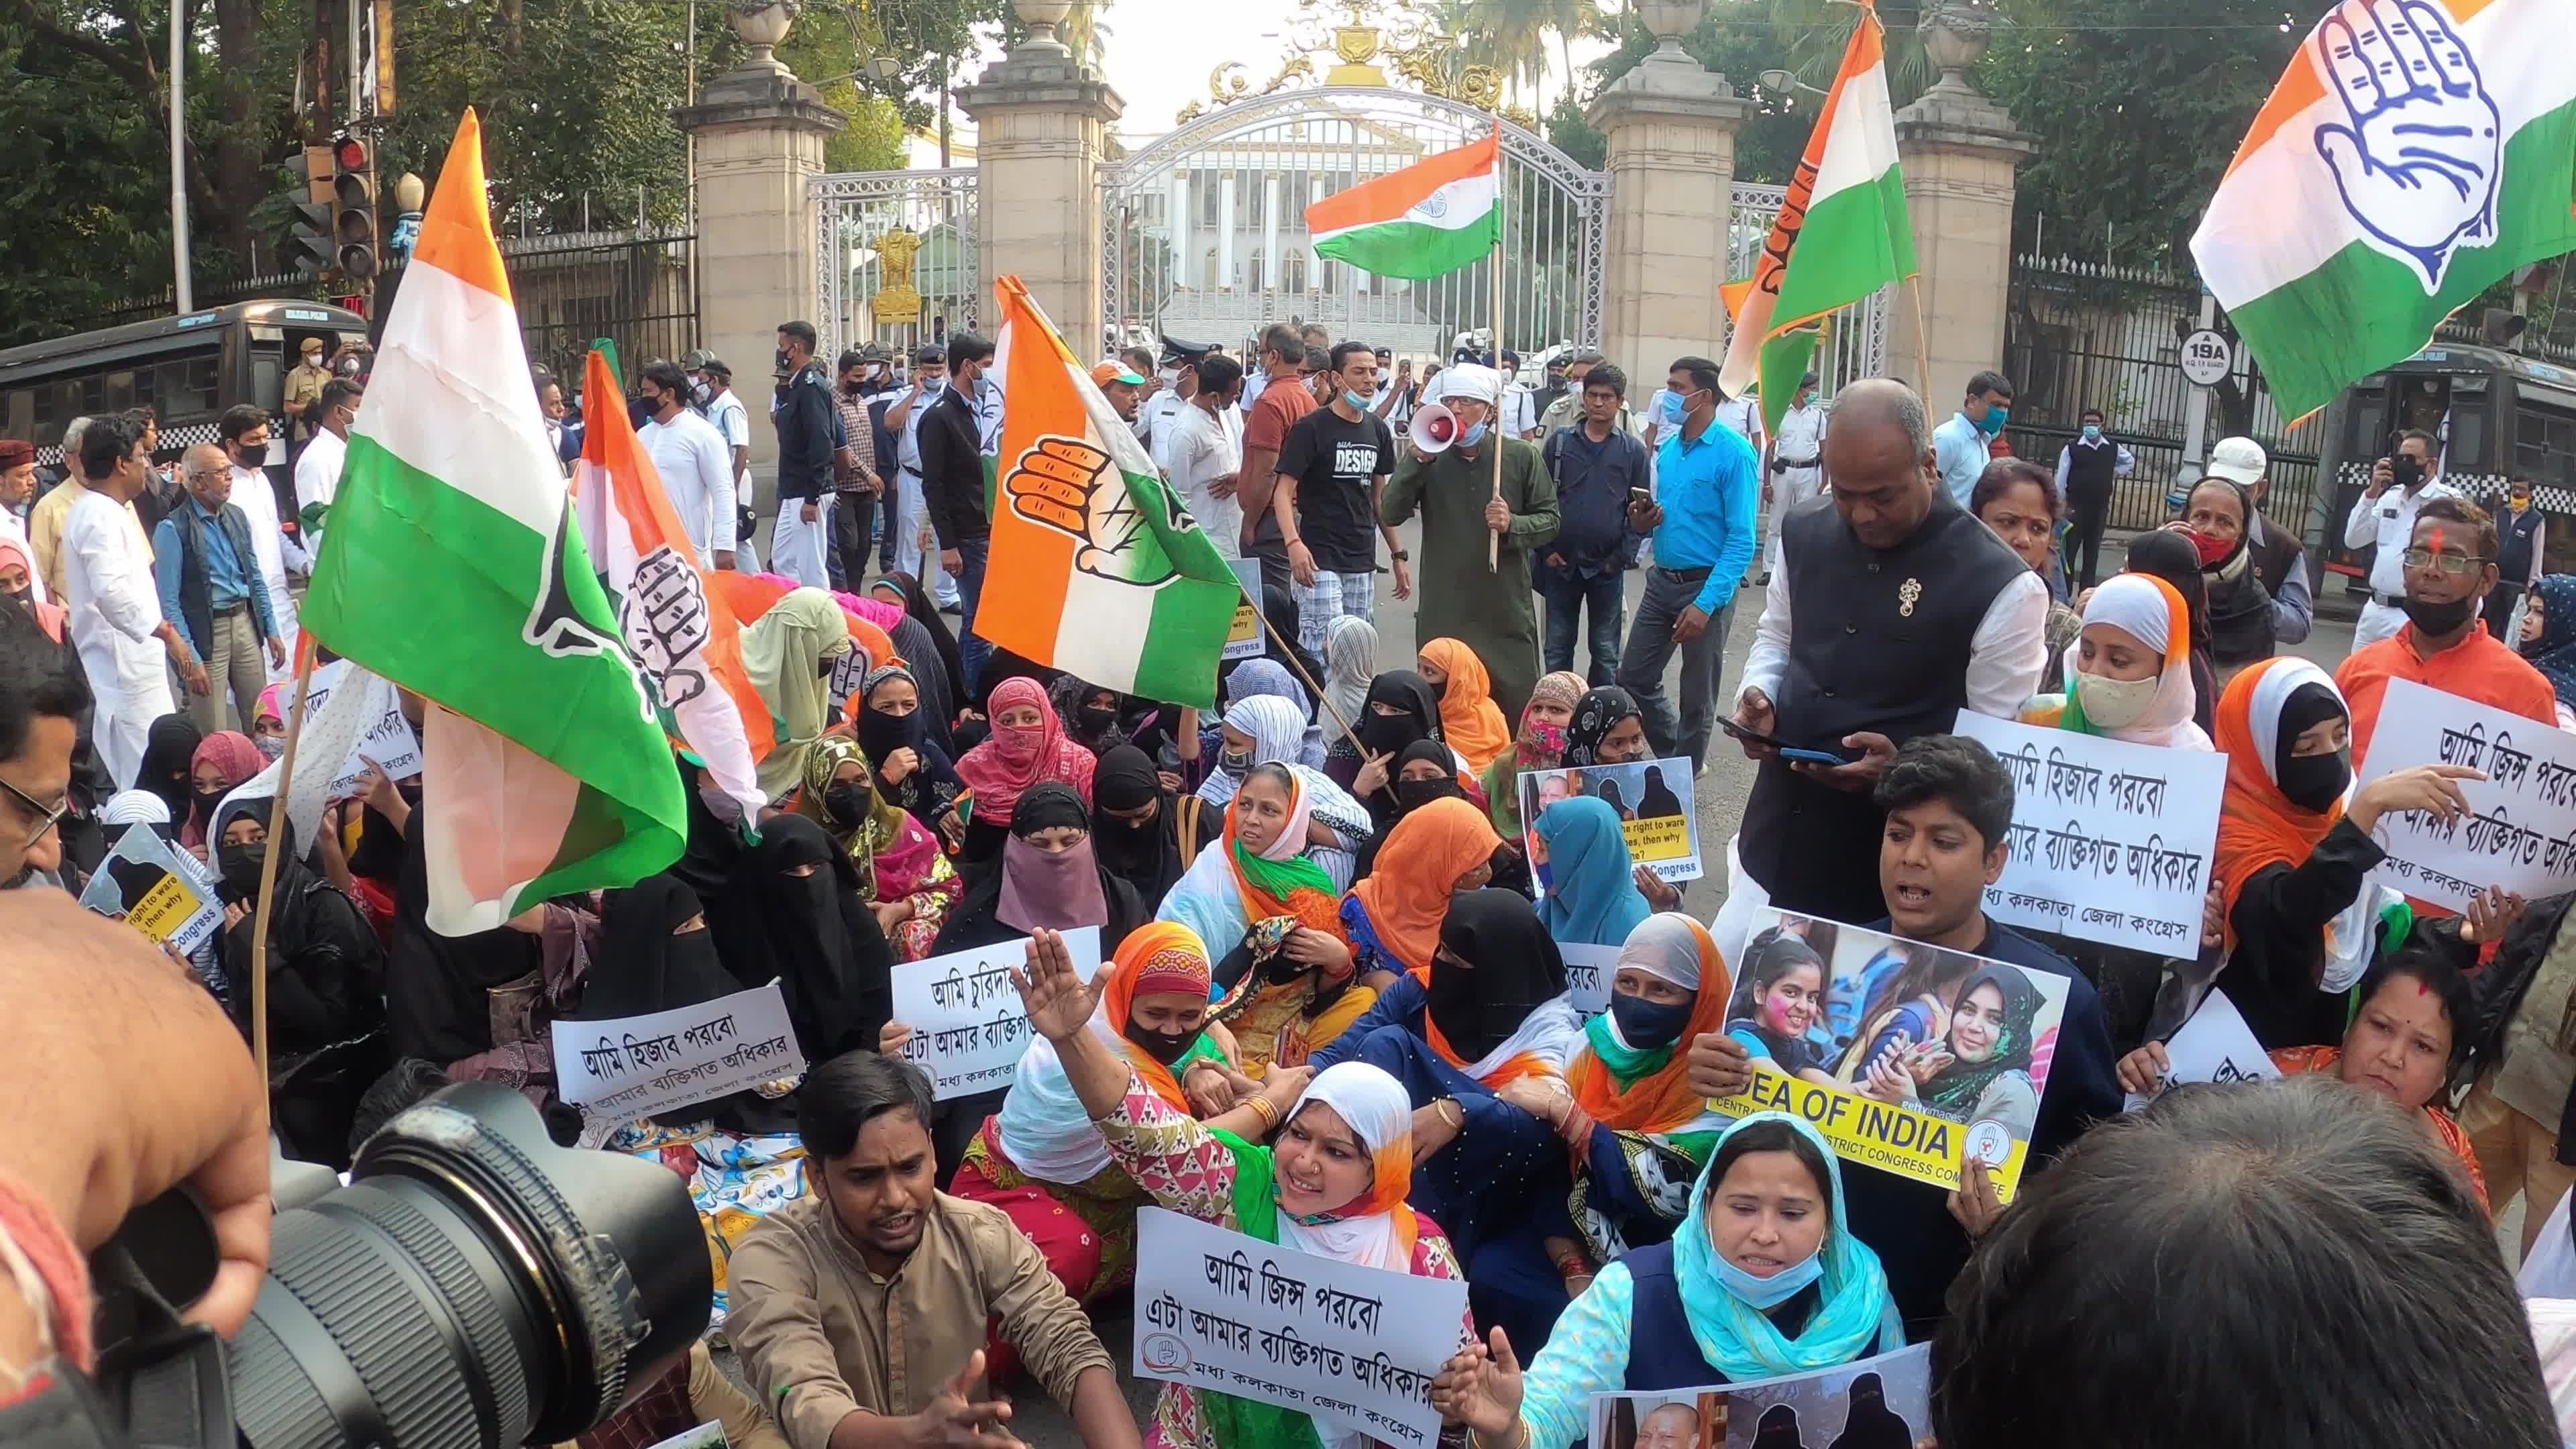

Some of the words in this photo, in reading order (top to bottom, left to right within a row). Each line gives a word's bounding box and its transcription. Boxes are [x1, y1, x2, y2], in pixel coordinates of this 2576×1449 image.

[2190, 343, 2225, 360] 19A
[1233, 620, 1248, 628] why
[1224, 642, 1260, 654] ongress
[2440, 722, 2487, 769] আমি
[2487, 731, 2532, 794] জিন্স
[2045, 746, 2103, 808] হিজাব
[2108, 767, 2167, 819] পরবো
[1633, 821, 1652, 833] right
[1655, 820, 1663, 829] to
[1666, 819, 1685, 828] ware
[1643, 835, 1661, 845] then
[1663, 832, 1680, 843] why
[2467, 806, 2544, 867] ব্যক্তিগত
[2045, 819, 2121, 881] ব্যক্তিগত
[2127, 833, 2203, 895] অধিকার
[2384, 854, 2416, 877] মধ্য
[145, 908, 165, 928] then
[166, 892, 183, 910] why
[146, 896, 157, 907] to
[157, 875, 177, 896] ware
[1985, 887, 2003, 906] ধ্য
[2008, 892, 2076, 921] কলকাতা
[2082, 906, 2125, 929] জেলা
[2131, 914, 2189, 941] কংগ্রেস
[930, 967, 965, 1012] আমি
[1564, 961, 1603, 993] রবো
[581, 1036, 626, 1083] আমি
[623, 1032, 682, 1072] হিজাব
[684, 1012, 738, 1050] পরবো
[649, 1060, 719, 1092] ব্যক্তিগত
[720, 1035, 788, 1069] অধিকার
[903, 1026, 930, 1063] এটা
[934, 1023, 979, 1059] আমার
[937, 1076, 961, 1088] মধ্য
[966, 1062, 1016, 1083] কলকাতা
[1802, 1088, 1851, 1127] OF
[1856, 1102, 1949, 1161] INDIA
[1868, 1147, 1933, 1175] CONGRESS
[1204, 1250, 1252, 1301] আমি
[1260, 1259, 1307, 1316] জিন্স
[1315, 1283, 1383, 1336] পরবো
[1146, 1289, 1183, 1336] এটা
[1189, 1309, 1252, 1356] আমার
[1259, 1325, 1345, 1377] ব্যক্তিগত
[1192, 1360, 1226, 1380] মধ্য
[1233, 1371, 1305, 1403] কলকাতা
[1313, 1394, 1357, 1417] জেলা
[1364, 1408, 1426, 1446] কংগ্রেস
